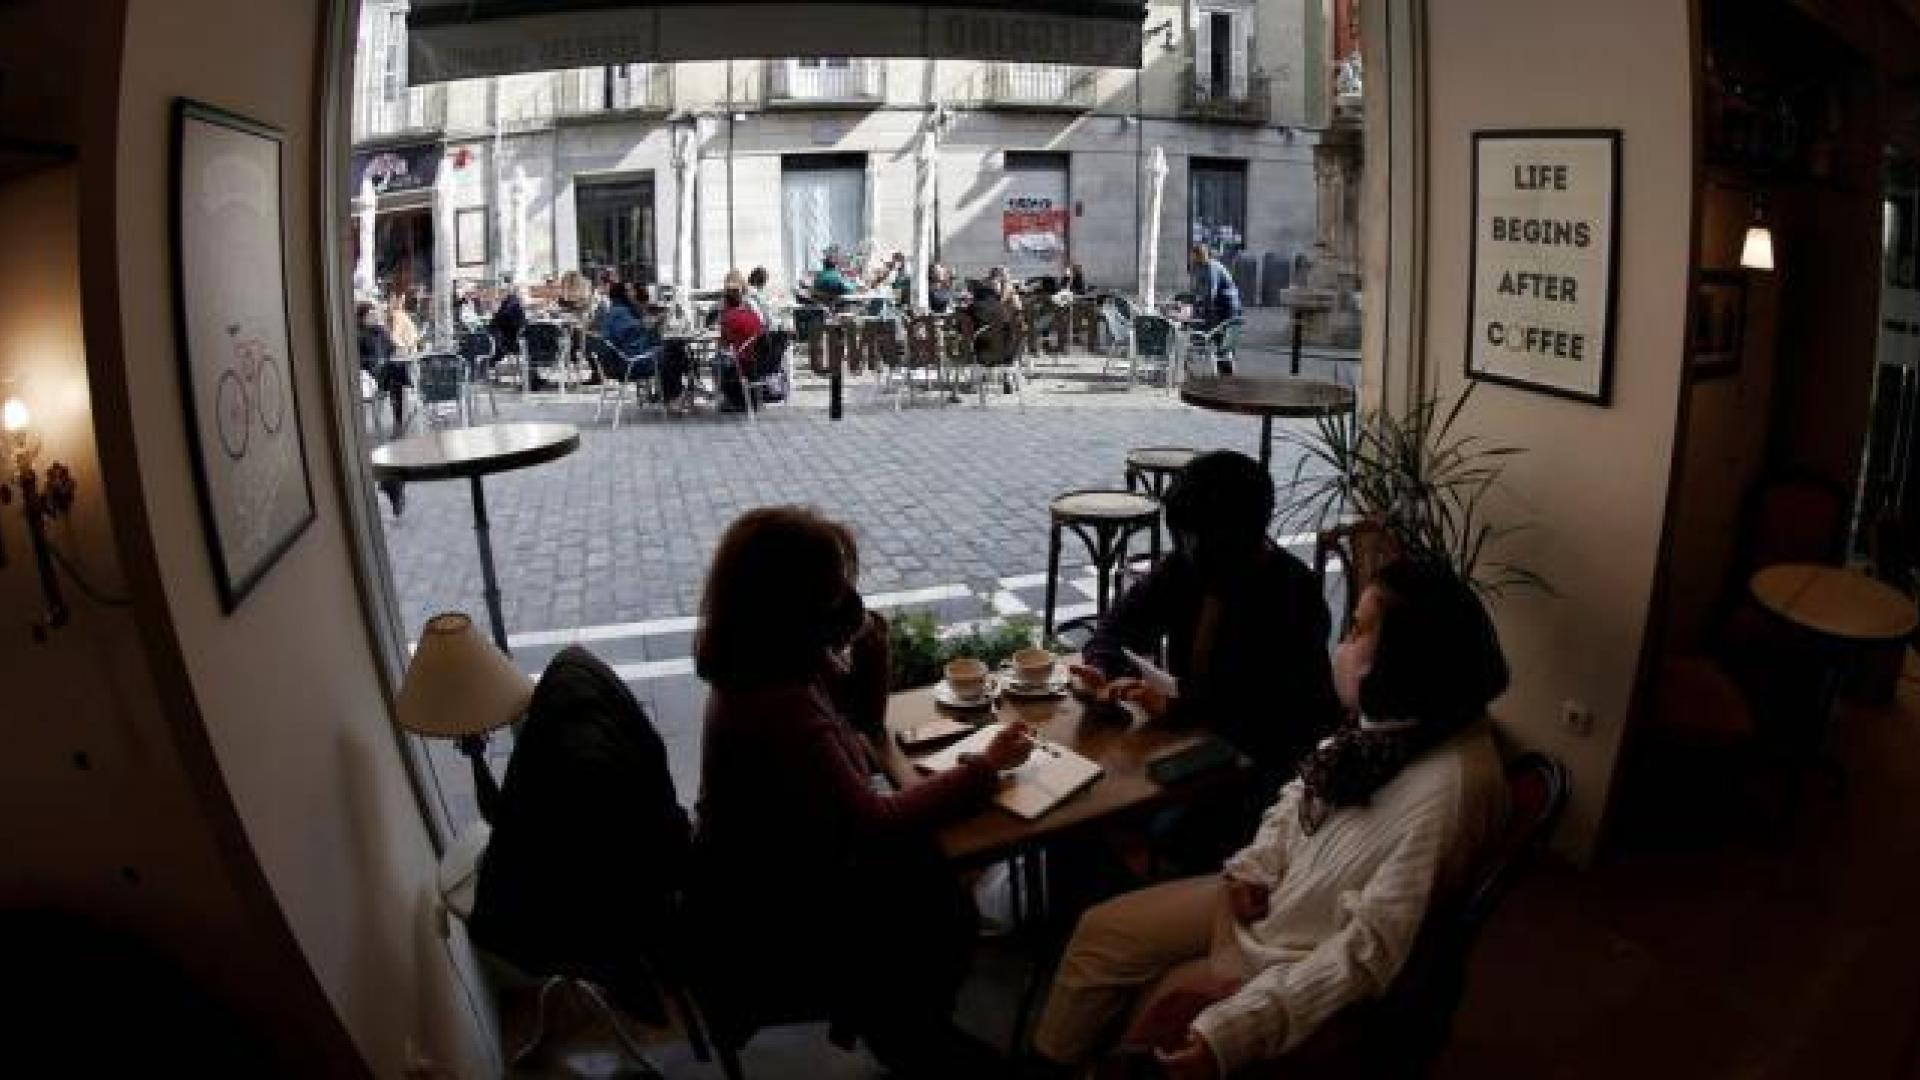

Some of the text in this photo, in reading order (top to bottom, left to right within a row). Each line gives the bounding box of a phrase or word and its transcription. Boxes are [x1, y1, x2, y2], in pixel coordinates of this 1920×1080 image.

[1514, 164, 1568, 191] LIFE
[1493, 216, 1591, 248] BEGINS
[1497, 269, 1576, 303] AFTER
[1487, 321, 1585, 361] COFFEE
